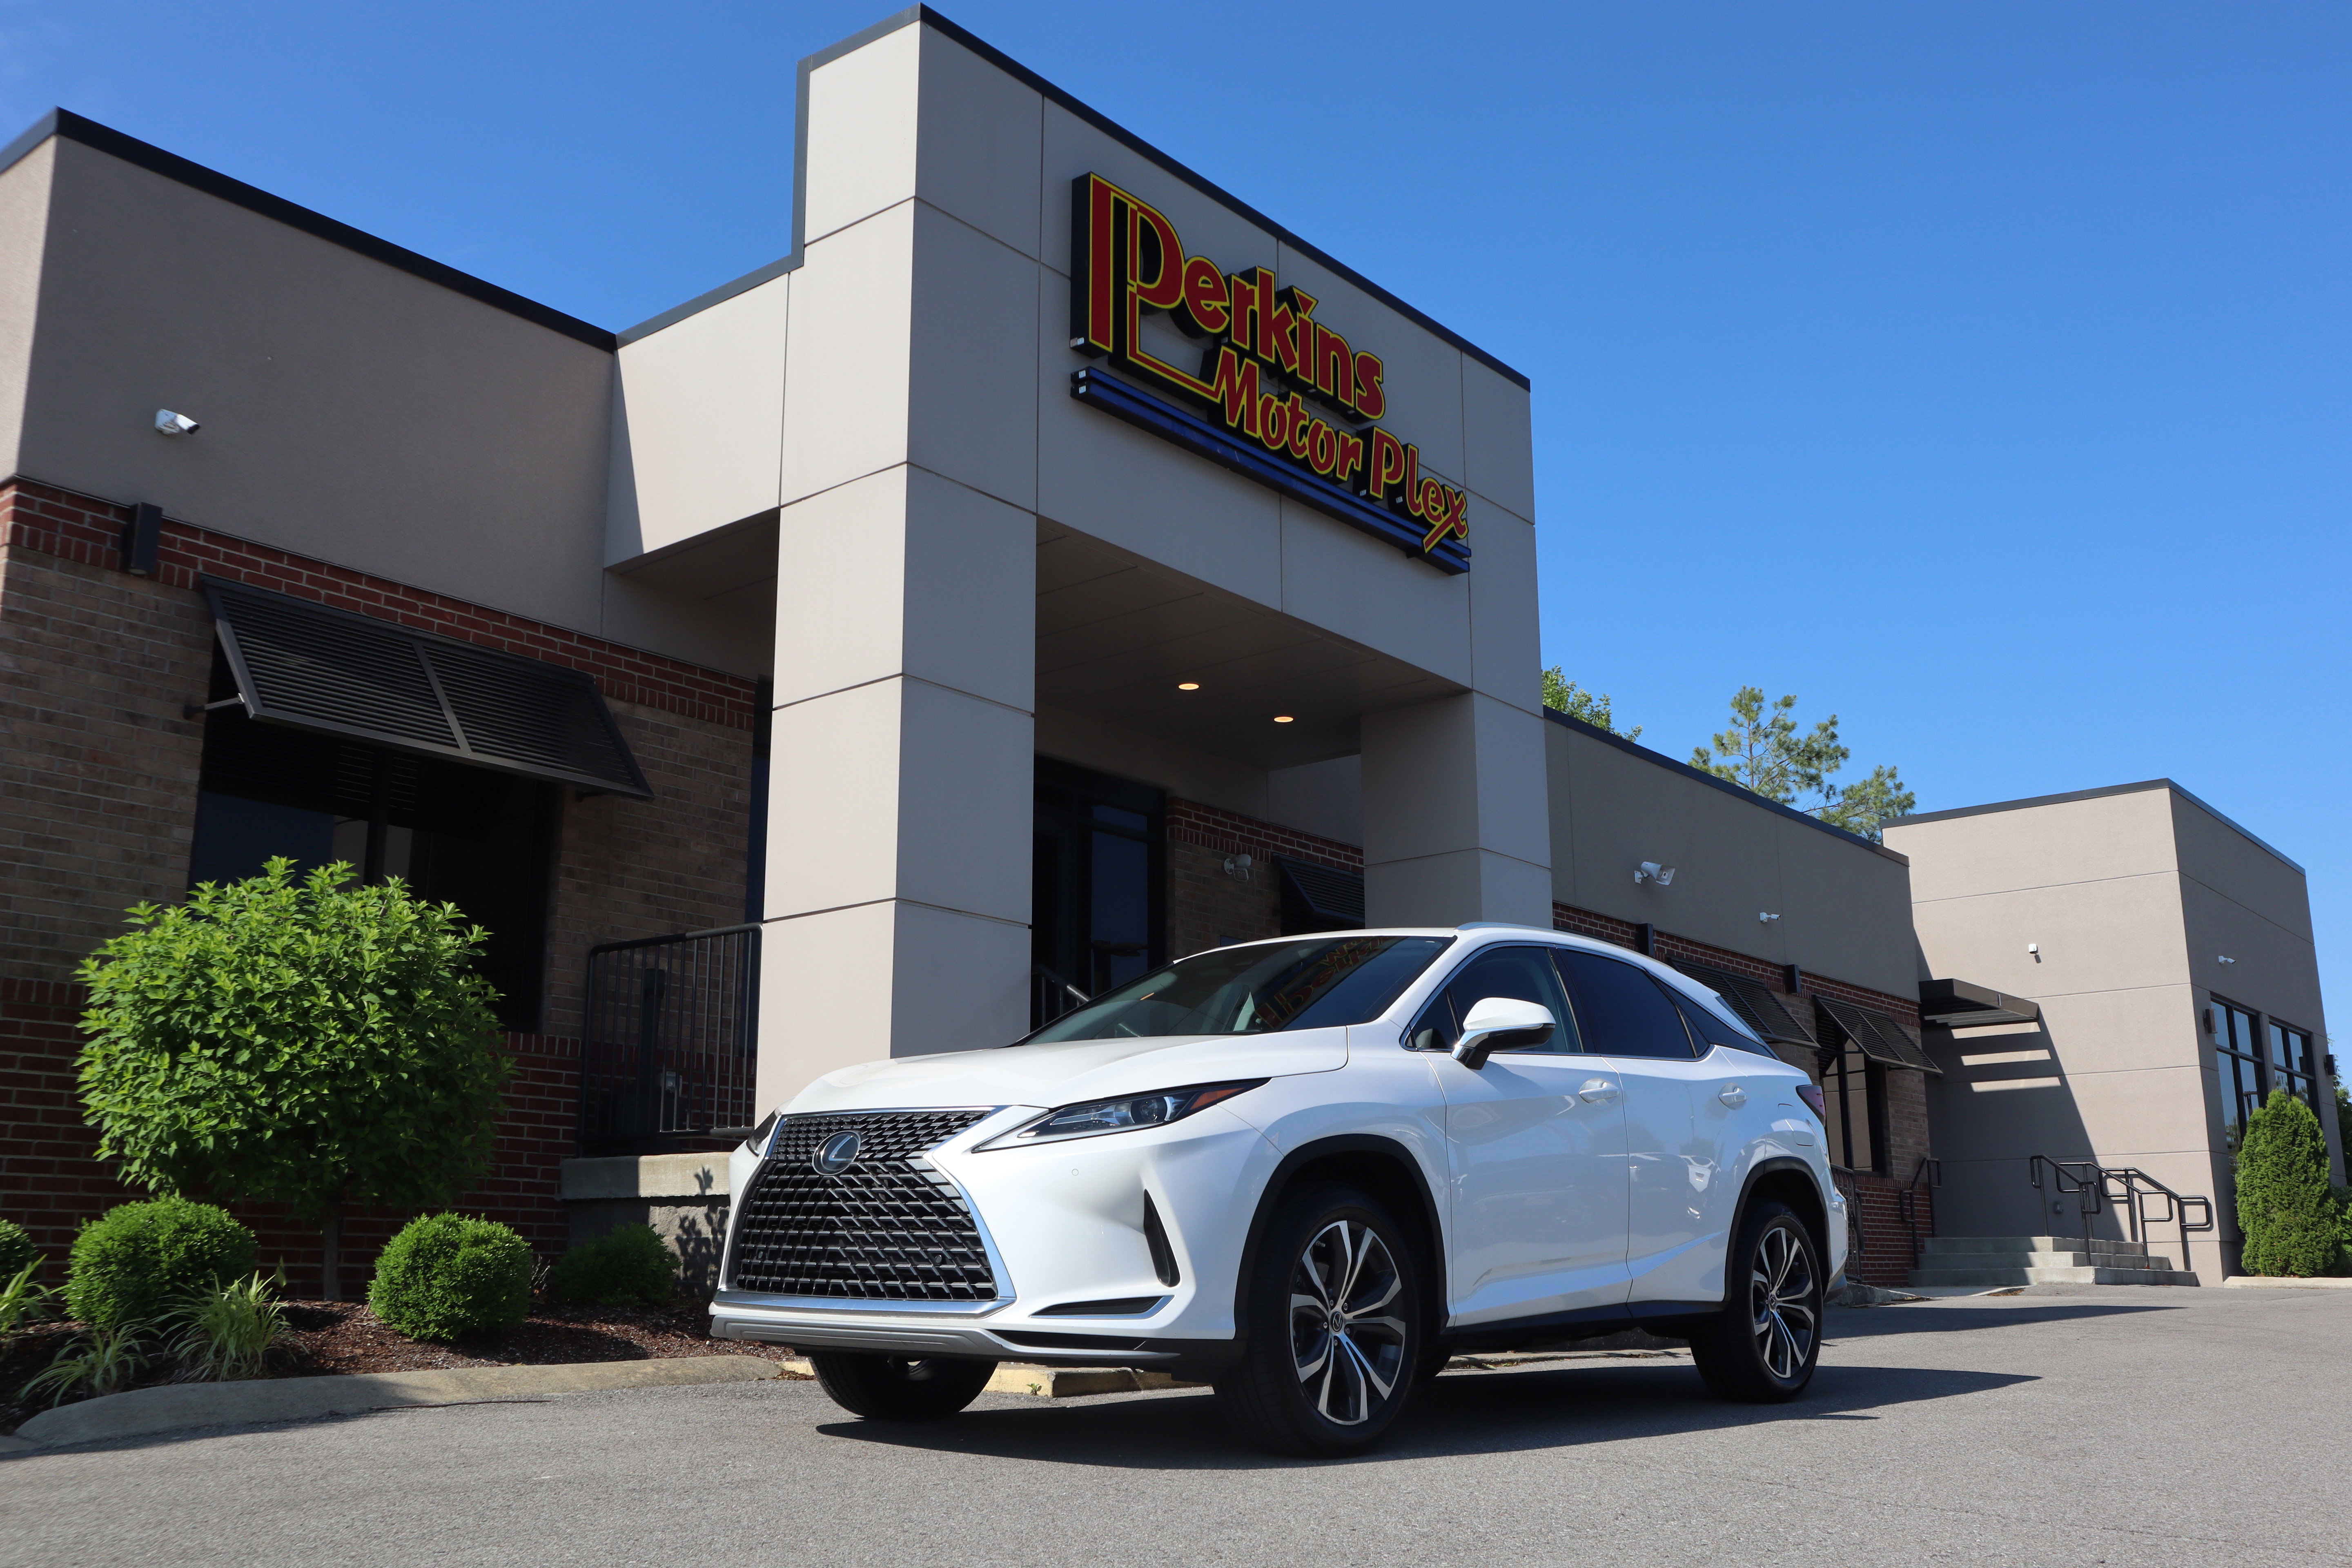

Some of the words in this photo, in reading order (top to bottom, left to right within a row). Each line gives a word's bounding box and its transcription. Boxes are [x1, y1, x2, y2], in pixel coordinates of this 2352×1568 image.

[1089, 172, 1385, 420] Perkins
[1215, 345, 1363, 481] Motor
[1370, 425, 1469, 552] Plex
